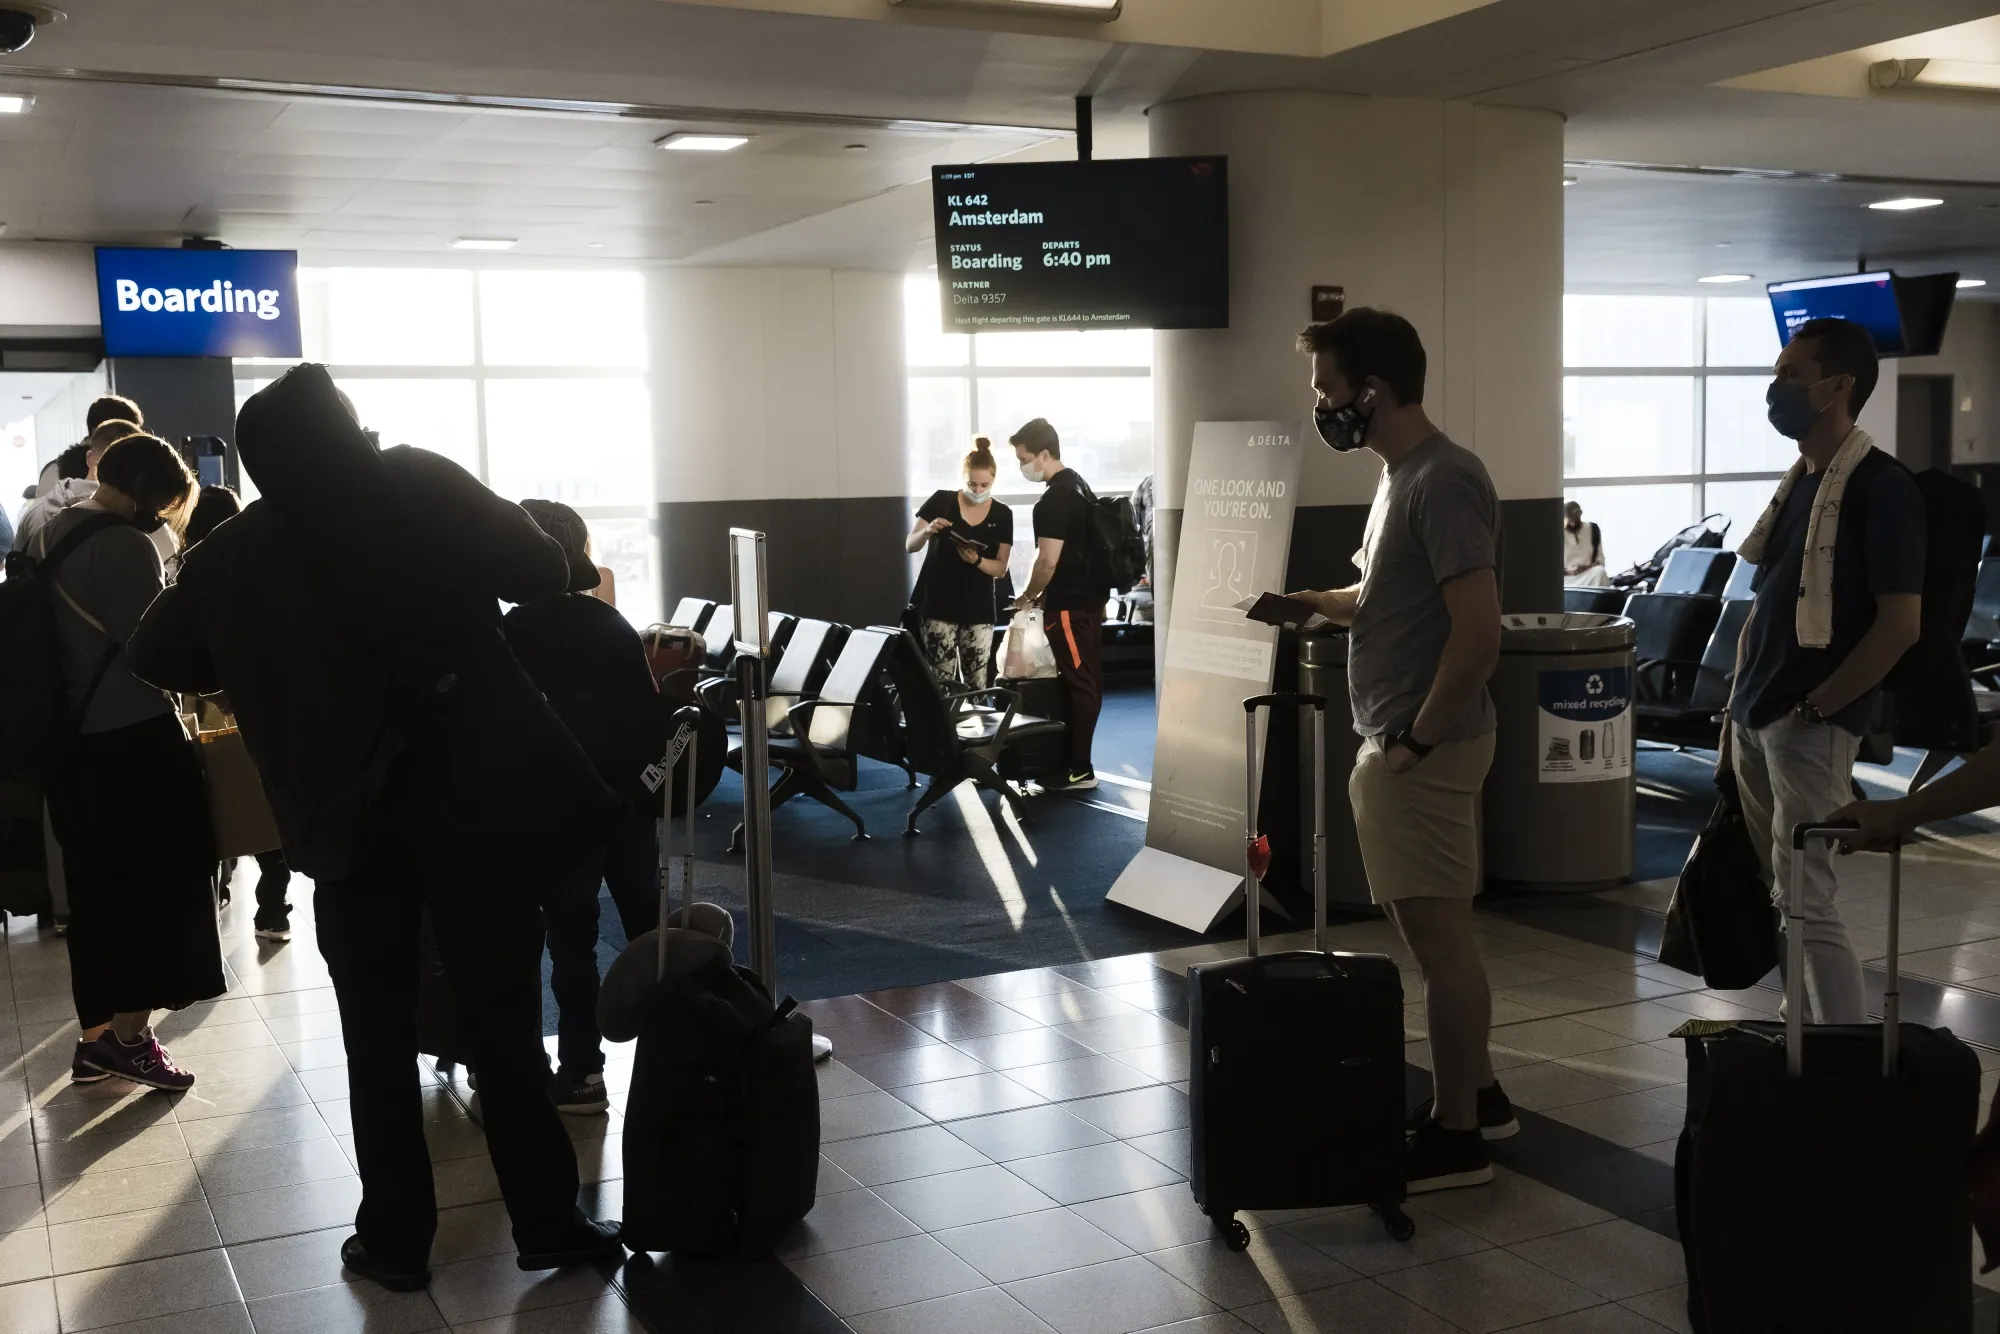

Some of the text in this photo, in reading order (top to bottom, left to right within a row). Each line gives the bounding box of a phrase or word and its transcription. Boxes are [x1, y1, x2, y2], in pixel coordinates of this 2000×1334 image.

[947, 194, 988, 206] KL 642
[949, 209, 1044, 226] Amsterdam
[950, 244, 982, 252] STATUS
[1042, 241, 1080, 250] DEPARTS
[951, 253, 1023, 271] Boarding
[1043, 251, 1111, 269] 6:40 pm
[952, 281, 990, 290] PARTNER
[116, 279, 280, 320] Boarding
[953, 293, 1006, 305] Delta 9357
[955, 317, 971, 325] Next
[971, 316, 989, 326] flight
[989, 315, 1022, 325] departing
[1022, 315, 1035, 323] this
[1035, 315, 1051, 324] gate
[1058, 314, 1081, 322] KL644
[1090, 313, 1131, 321] Amsterdam
[1257, 435, 1290, 446] DELTA
[1194, 479, 1286, 498] ONE LOOK AND
[1204, 500, 1272, 520] YOU'RE ON.
[1553, 696, 1626, 710] mixed recycling
